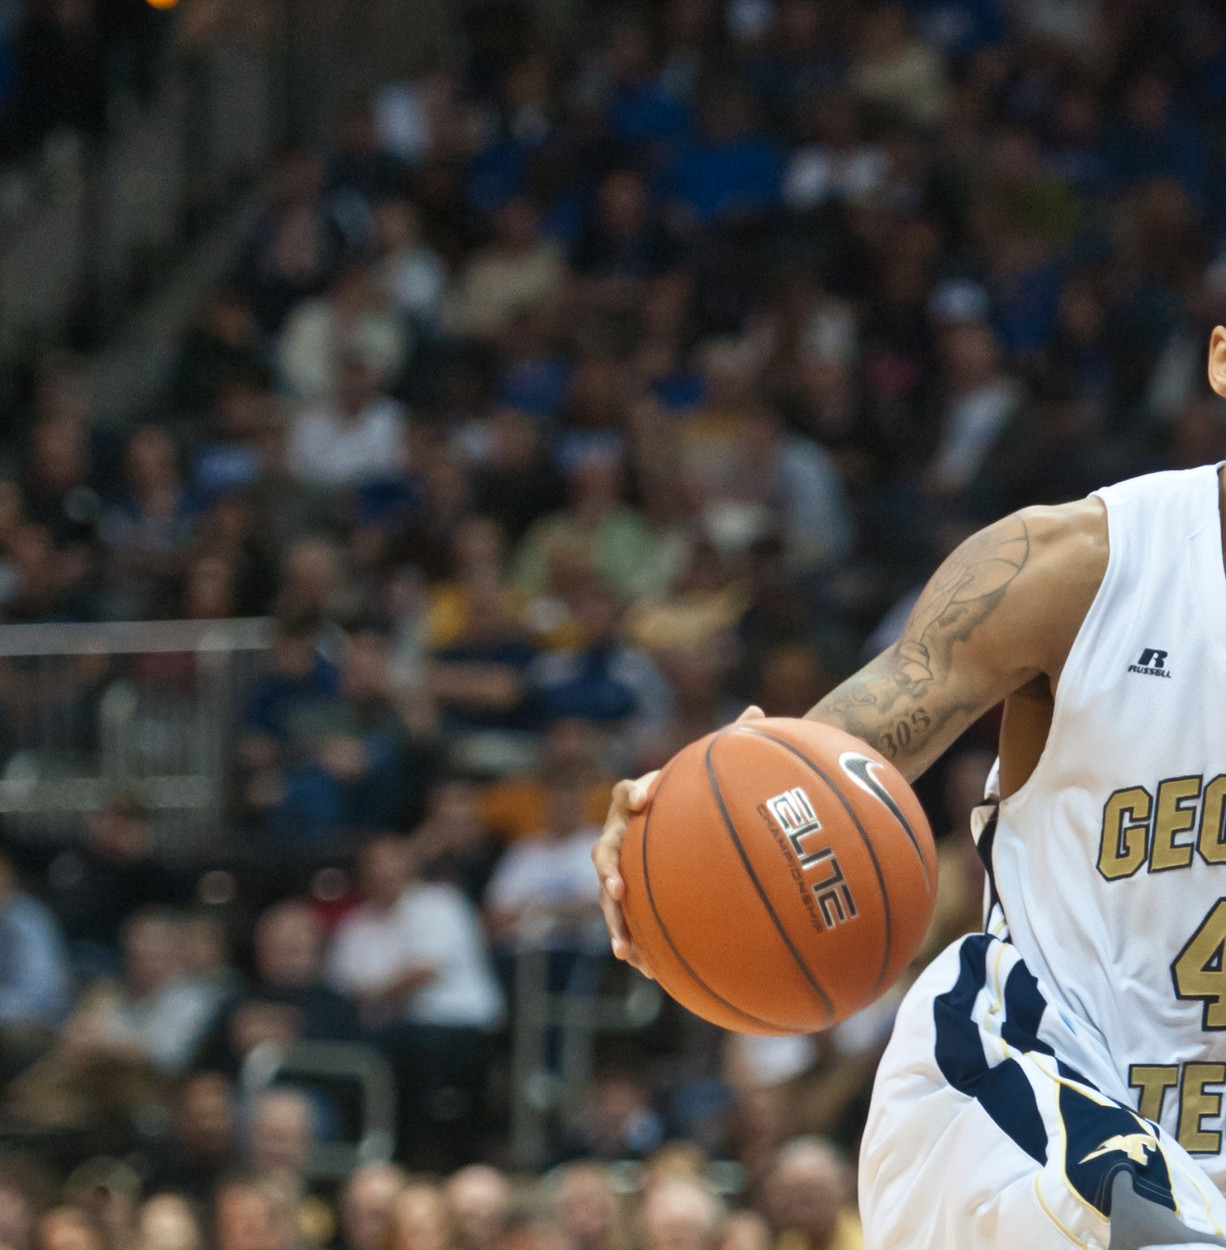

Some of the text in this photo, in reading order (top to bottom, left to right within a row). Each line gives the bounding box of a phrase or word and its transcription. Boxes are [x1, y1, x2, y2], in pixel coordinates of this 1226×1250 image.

[1127, 664, 1172, 679] RUSSELL
[880, 707, 931, 759] 305
[756, 803, 823, 933] CHAMPIONSHIP
[766, 786, 858, 930] ELITE
